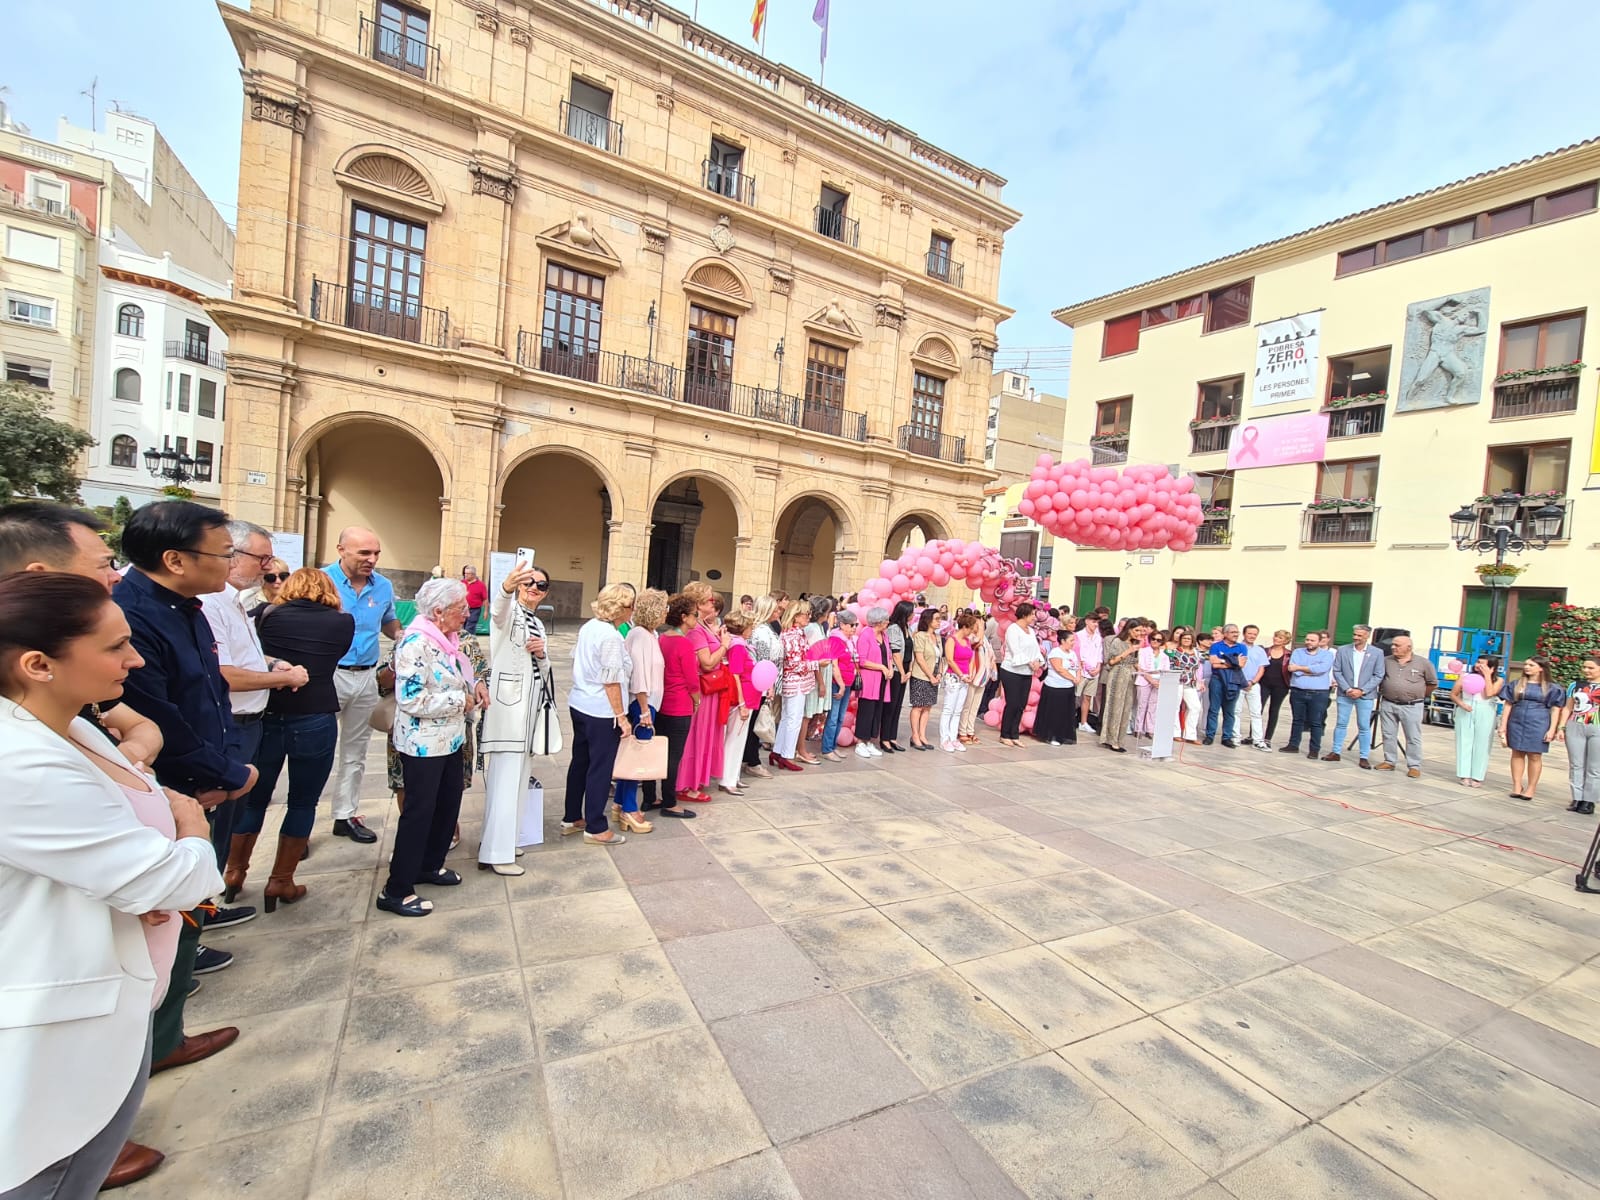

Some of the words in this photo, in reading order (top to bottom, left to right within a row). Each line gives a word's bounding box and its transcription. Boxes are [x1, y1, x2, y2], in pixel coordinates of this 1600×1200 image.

[1268, 340, 1305, 353] POBRESA
[1267, 347, 1304, 365] ZERO
[1259, 383, 1272, 392] LES
[1273, 377, 1310, 389] PERSONES
[1270, 389, 1296, 399] PRIMER
